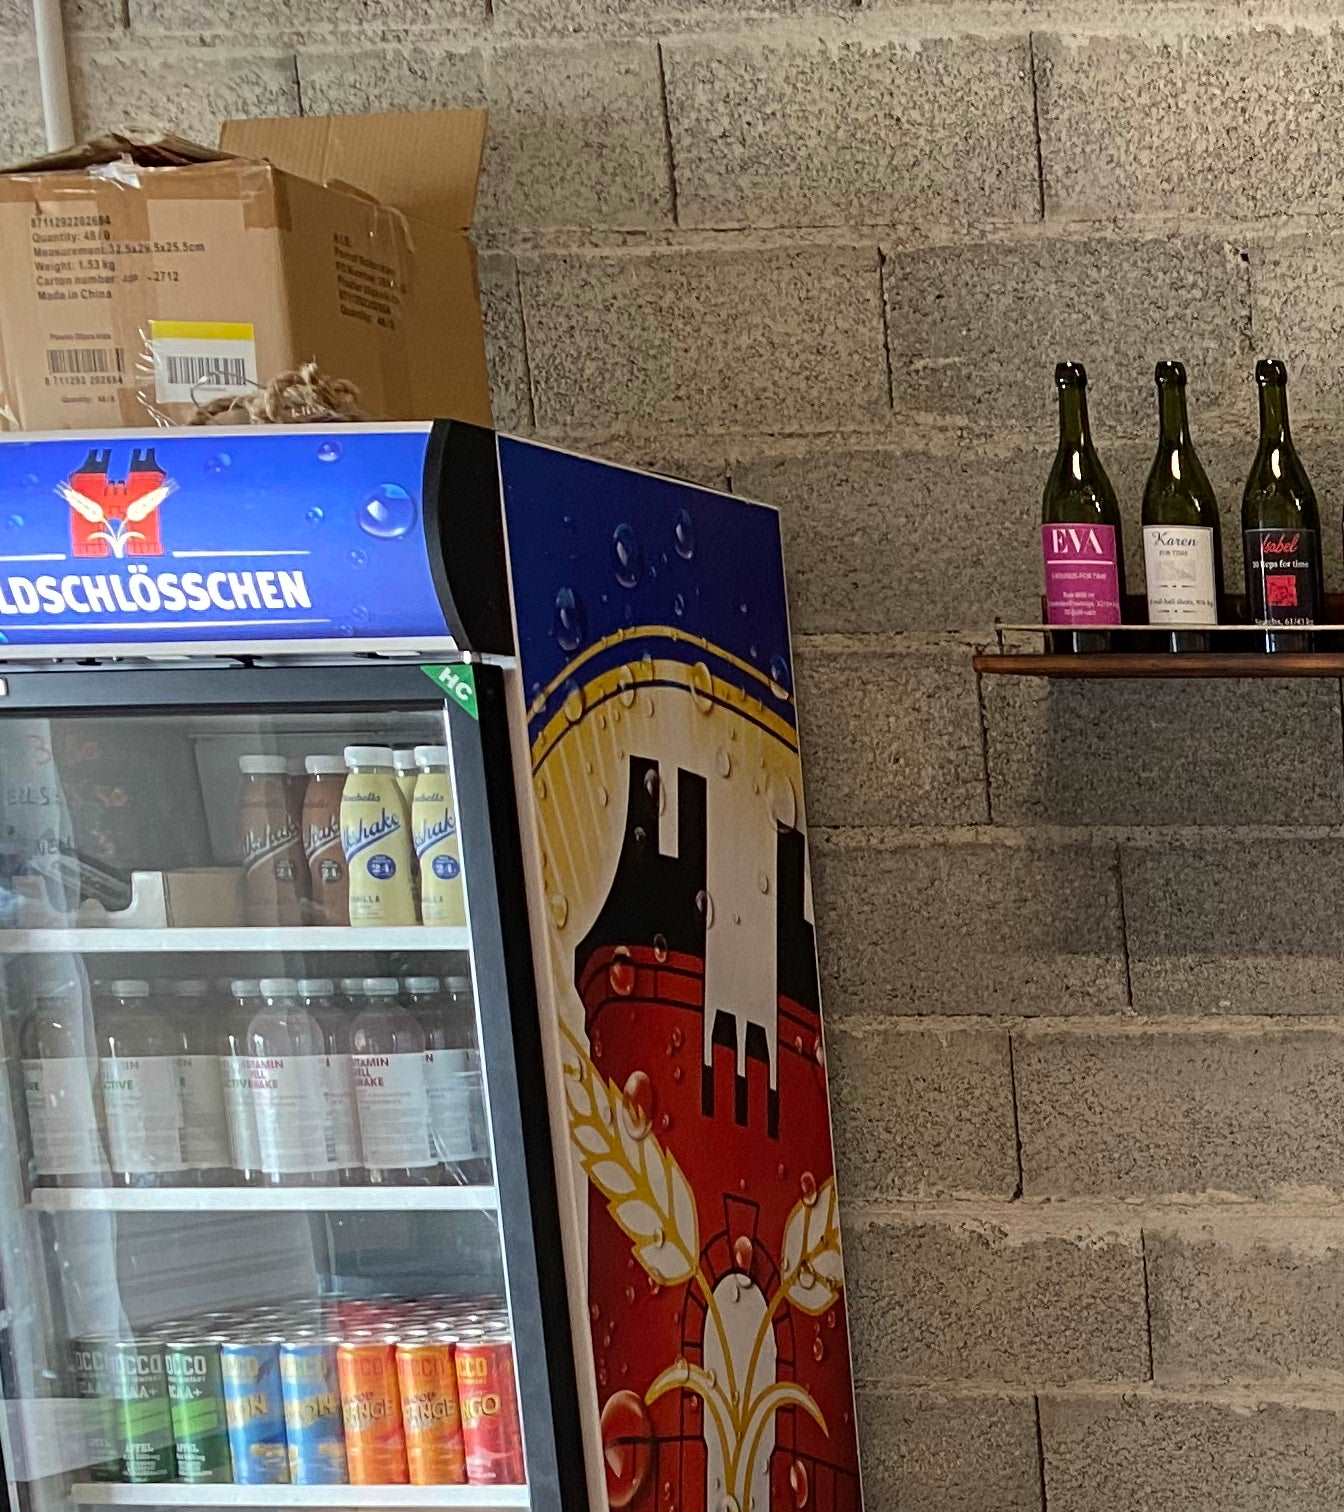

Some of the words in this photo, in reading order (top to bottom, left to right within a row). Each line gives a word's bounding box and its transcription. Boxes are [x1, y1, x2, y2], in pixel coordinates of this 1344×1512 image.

[32, 231, 80, 243] Quantity:
[35, 261, 74, 273] Weight:
[103, 260, 115, 272] kg
[36, 275, 72, 286] Carton
[38, 291, 66, 300] Made
[67, 290, 78, 299] in
[80, 289, 112, 299] China
[1052, 528, 1103, 554] EVA
[1151, 531, 1198, 547] Karen
[1280, 560, 1290, 568] for
[1292, 560, 1309, 568] time
[438, 666, 473, 701] HC
